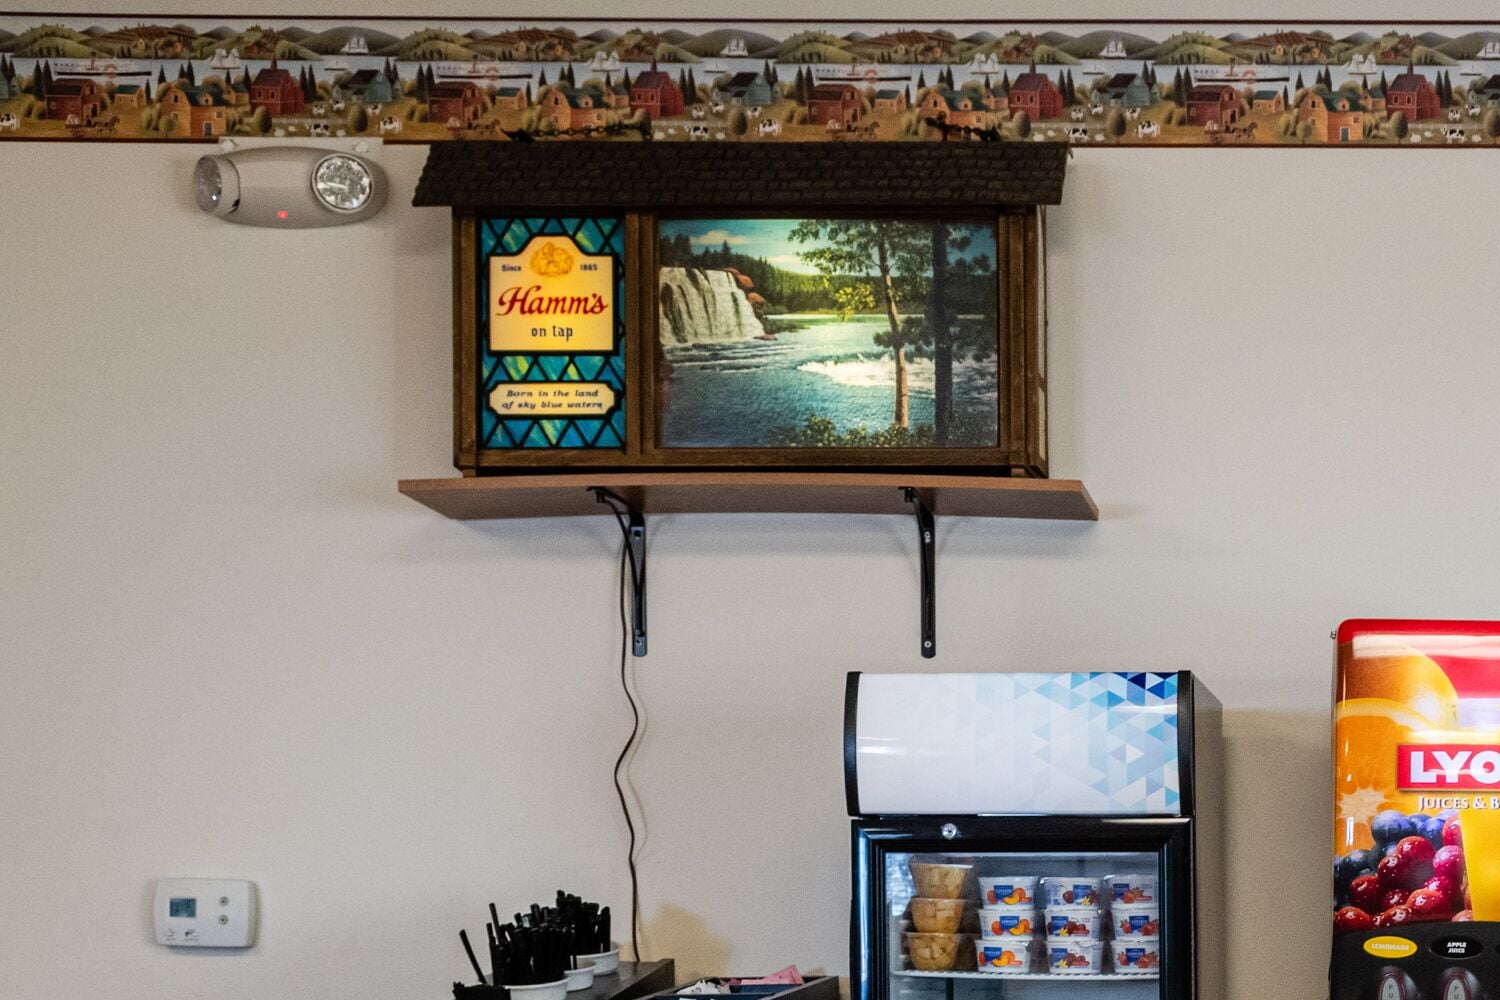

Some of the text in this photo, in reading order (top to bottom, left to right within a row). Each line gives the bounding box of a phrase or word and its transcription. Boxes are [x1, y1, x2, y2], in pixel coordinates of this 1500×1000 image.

[501, 264, 522, 272] Since
[496, 285, 609, 317] Hamm's
[531, 325, 573, 342] on tap
[506, 389, 599, 397] Born in the land
[502, 401, 514, 410] of
[518, 401, 536, 410] sky
[541, 401, 563, 409] blue
[1418, 796, 1470, 811] JUICES
[1472, 797, 1485, 810] &
